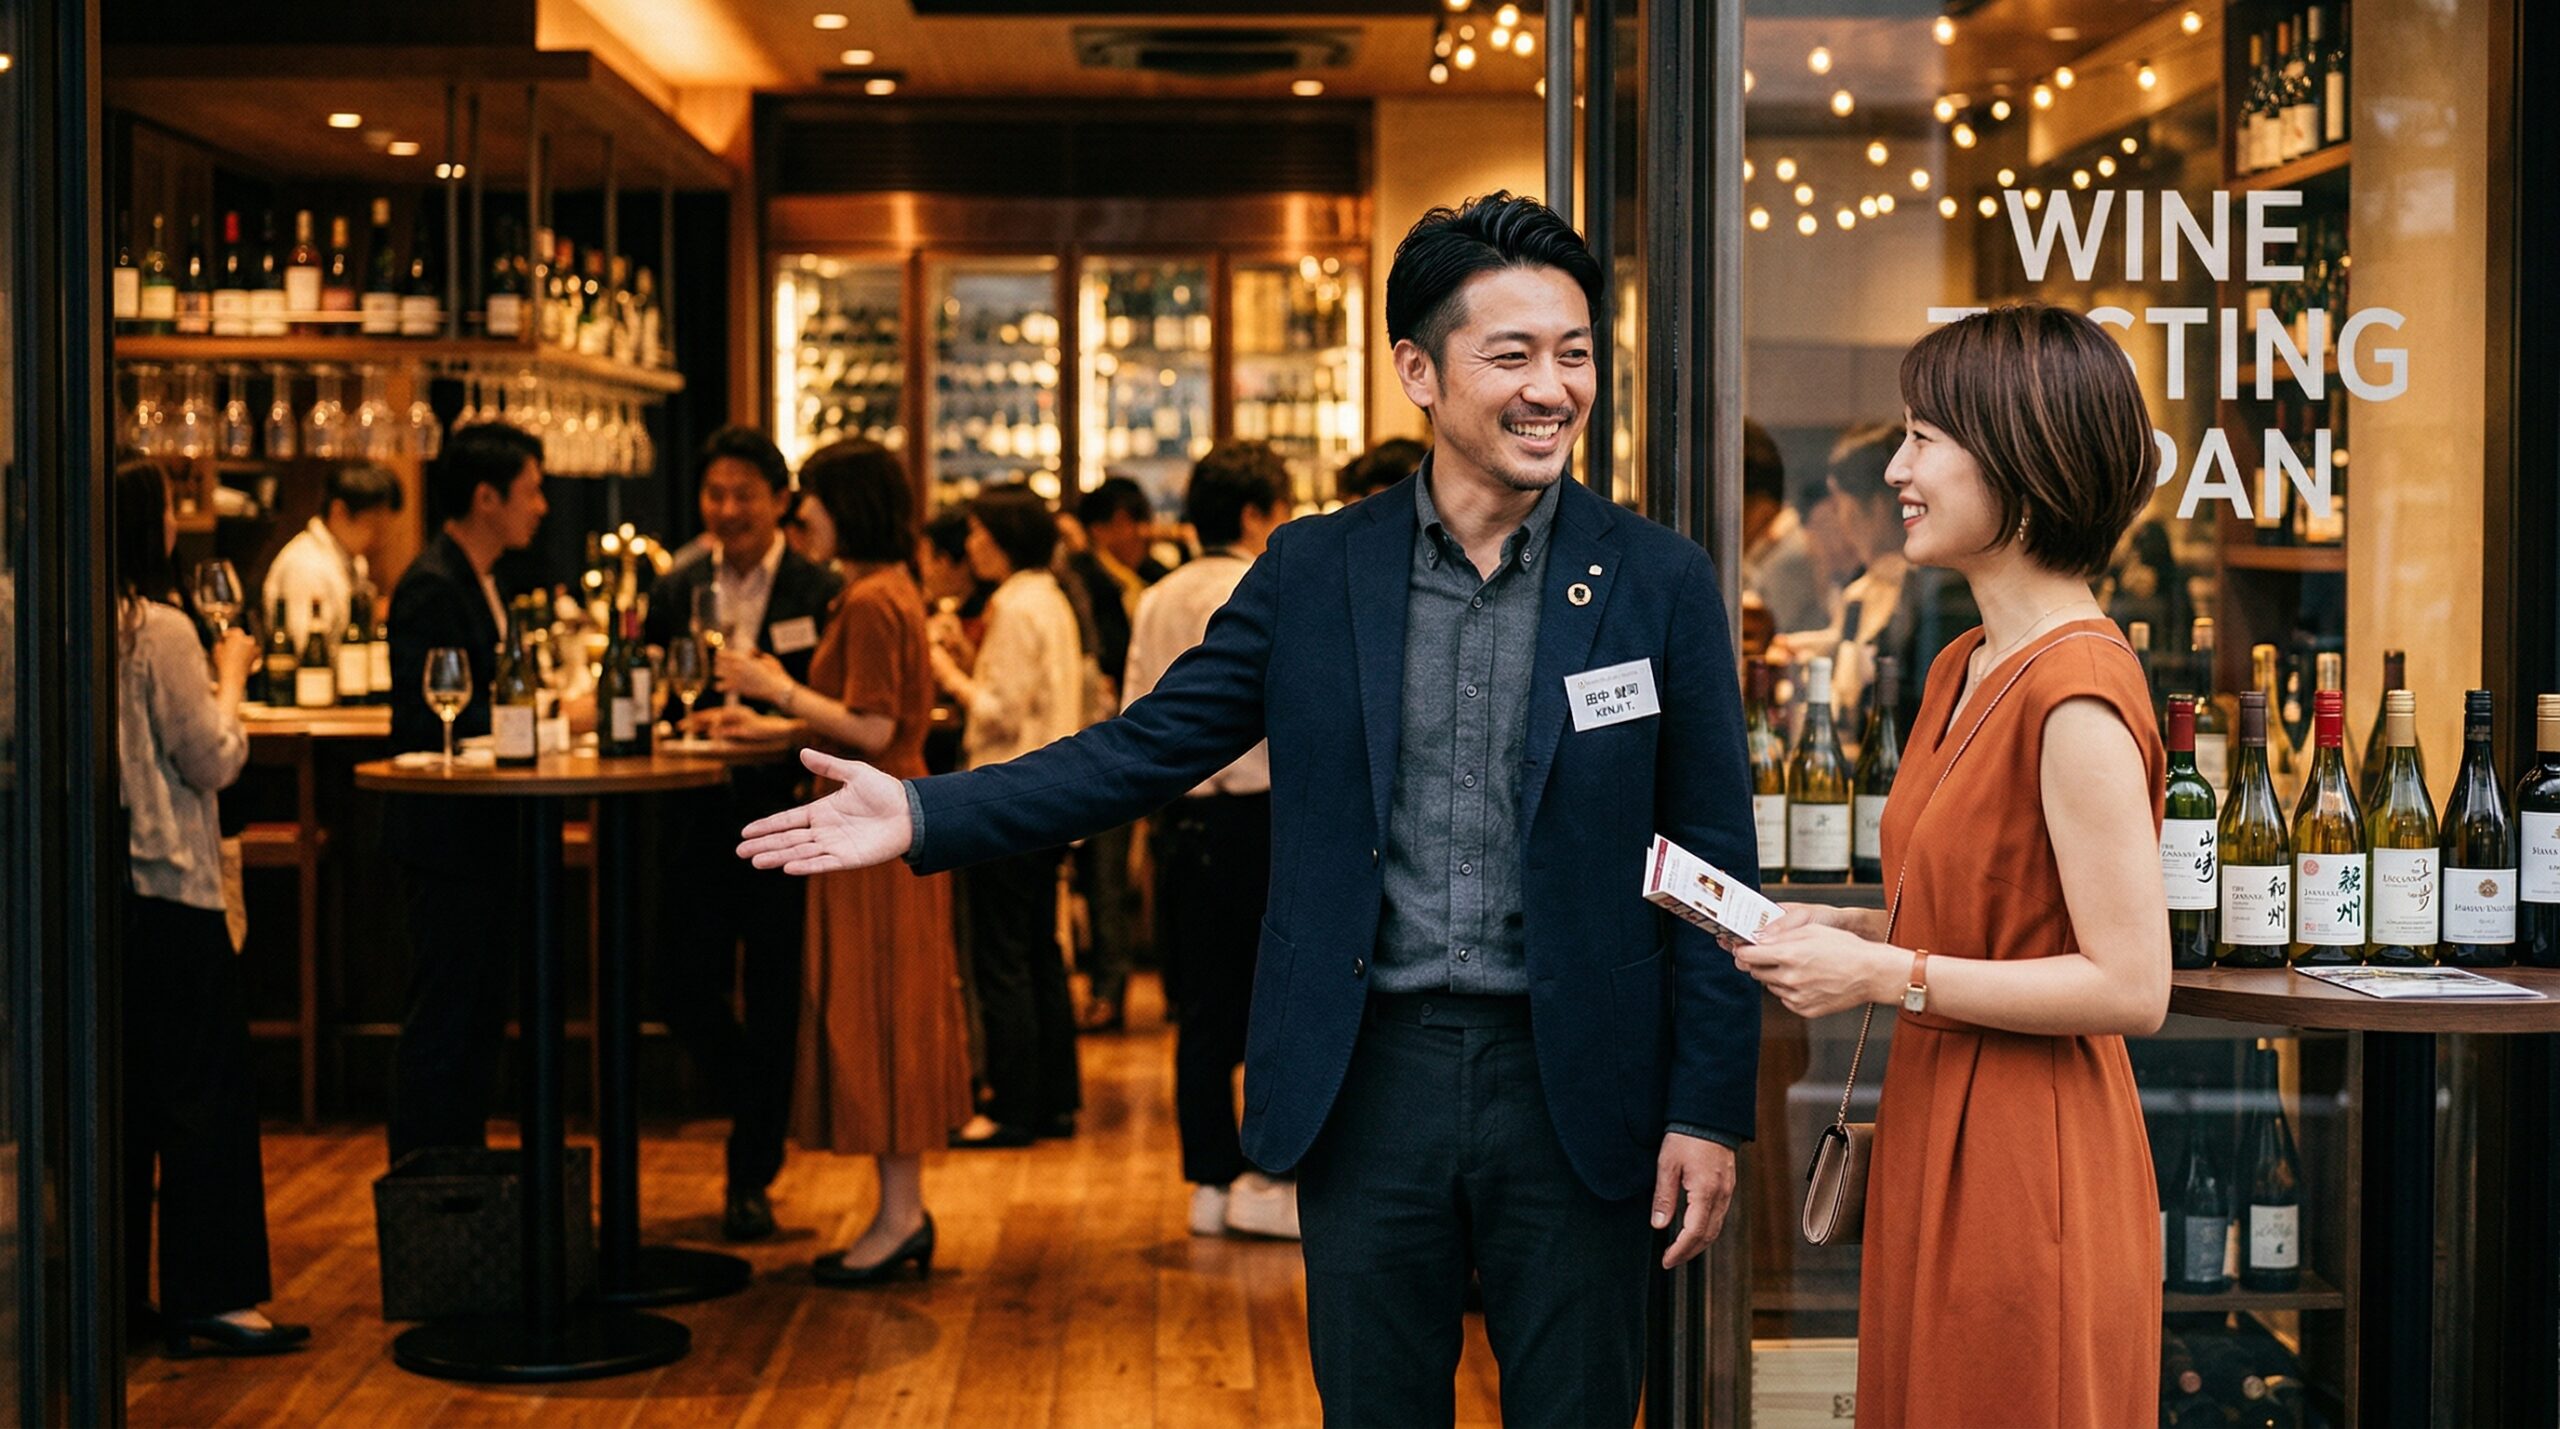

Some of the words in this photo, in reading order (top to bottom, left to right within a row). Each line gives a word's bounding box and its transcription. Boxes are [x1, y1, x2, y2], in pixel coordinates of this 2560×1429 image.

[2003, 189, 2304, 282] WINE
[1927, 306, 2409, 402] TING
[1585, 690, 1610, 706] 田中
